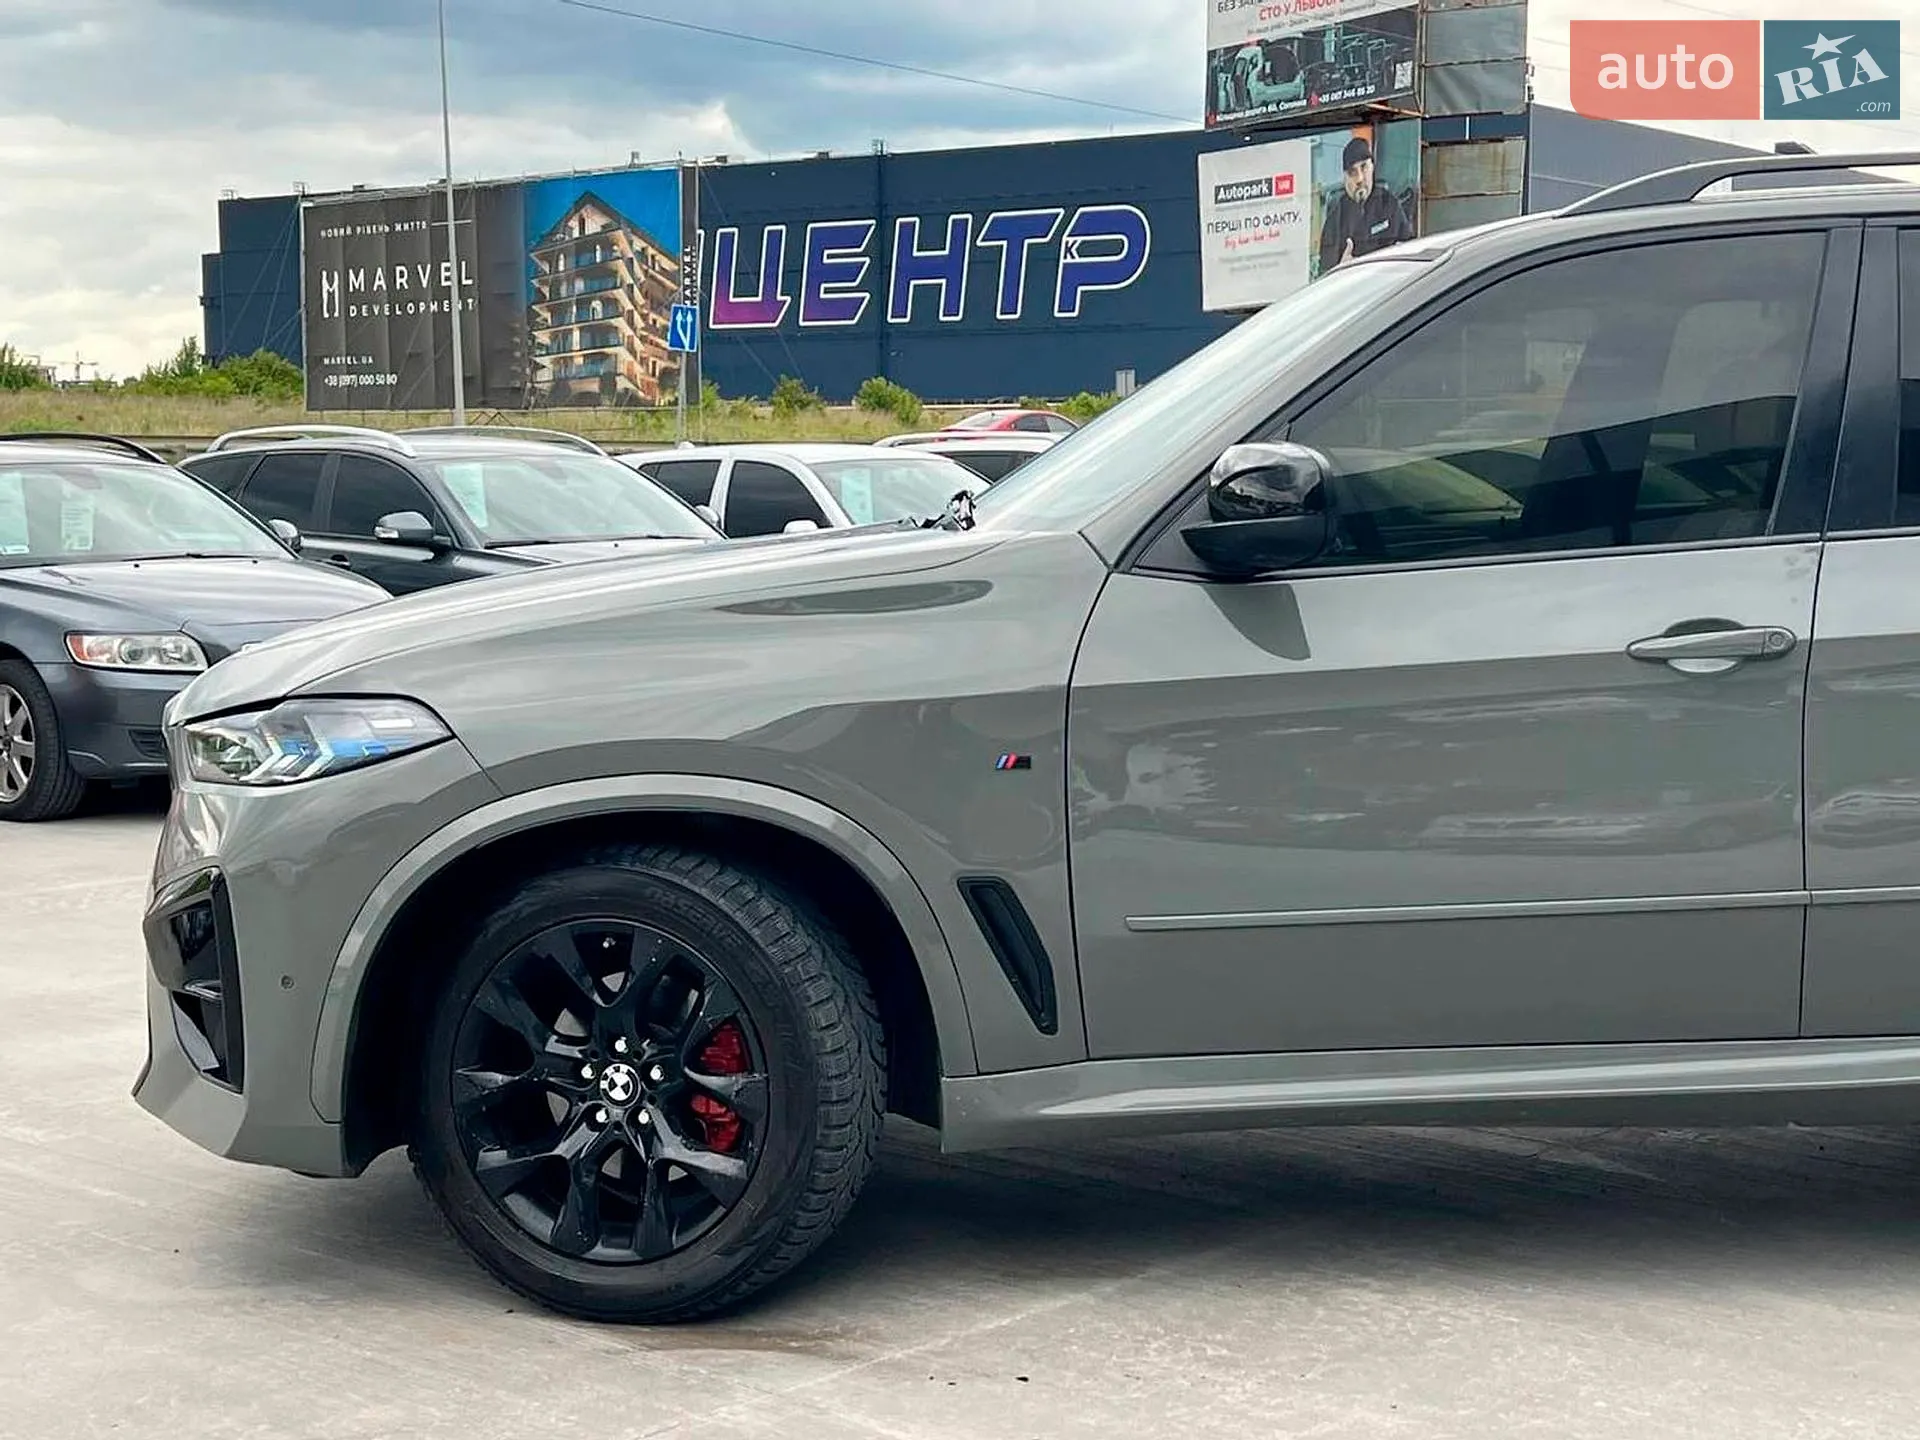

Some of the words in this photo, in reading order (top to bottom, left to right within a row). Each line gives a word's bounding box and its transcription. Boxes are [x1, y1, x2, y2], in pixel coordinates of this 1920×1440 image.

[1260, 5, 1281, 20] СТО
[1284, 3, 1291, 16] У
[1217, 179, 1270, 201] Autopark
[1207, 219, 1242, 235] ПЕРШІ
[1244, 216, 1260, 229] ПО
[349, 260, 473, 292] MARVEL
[359, 374, 374, 386] 000
